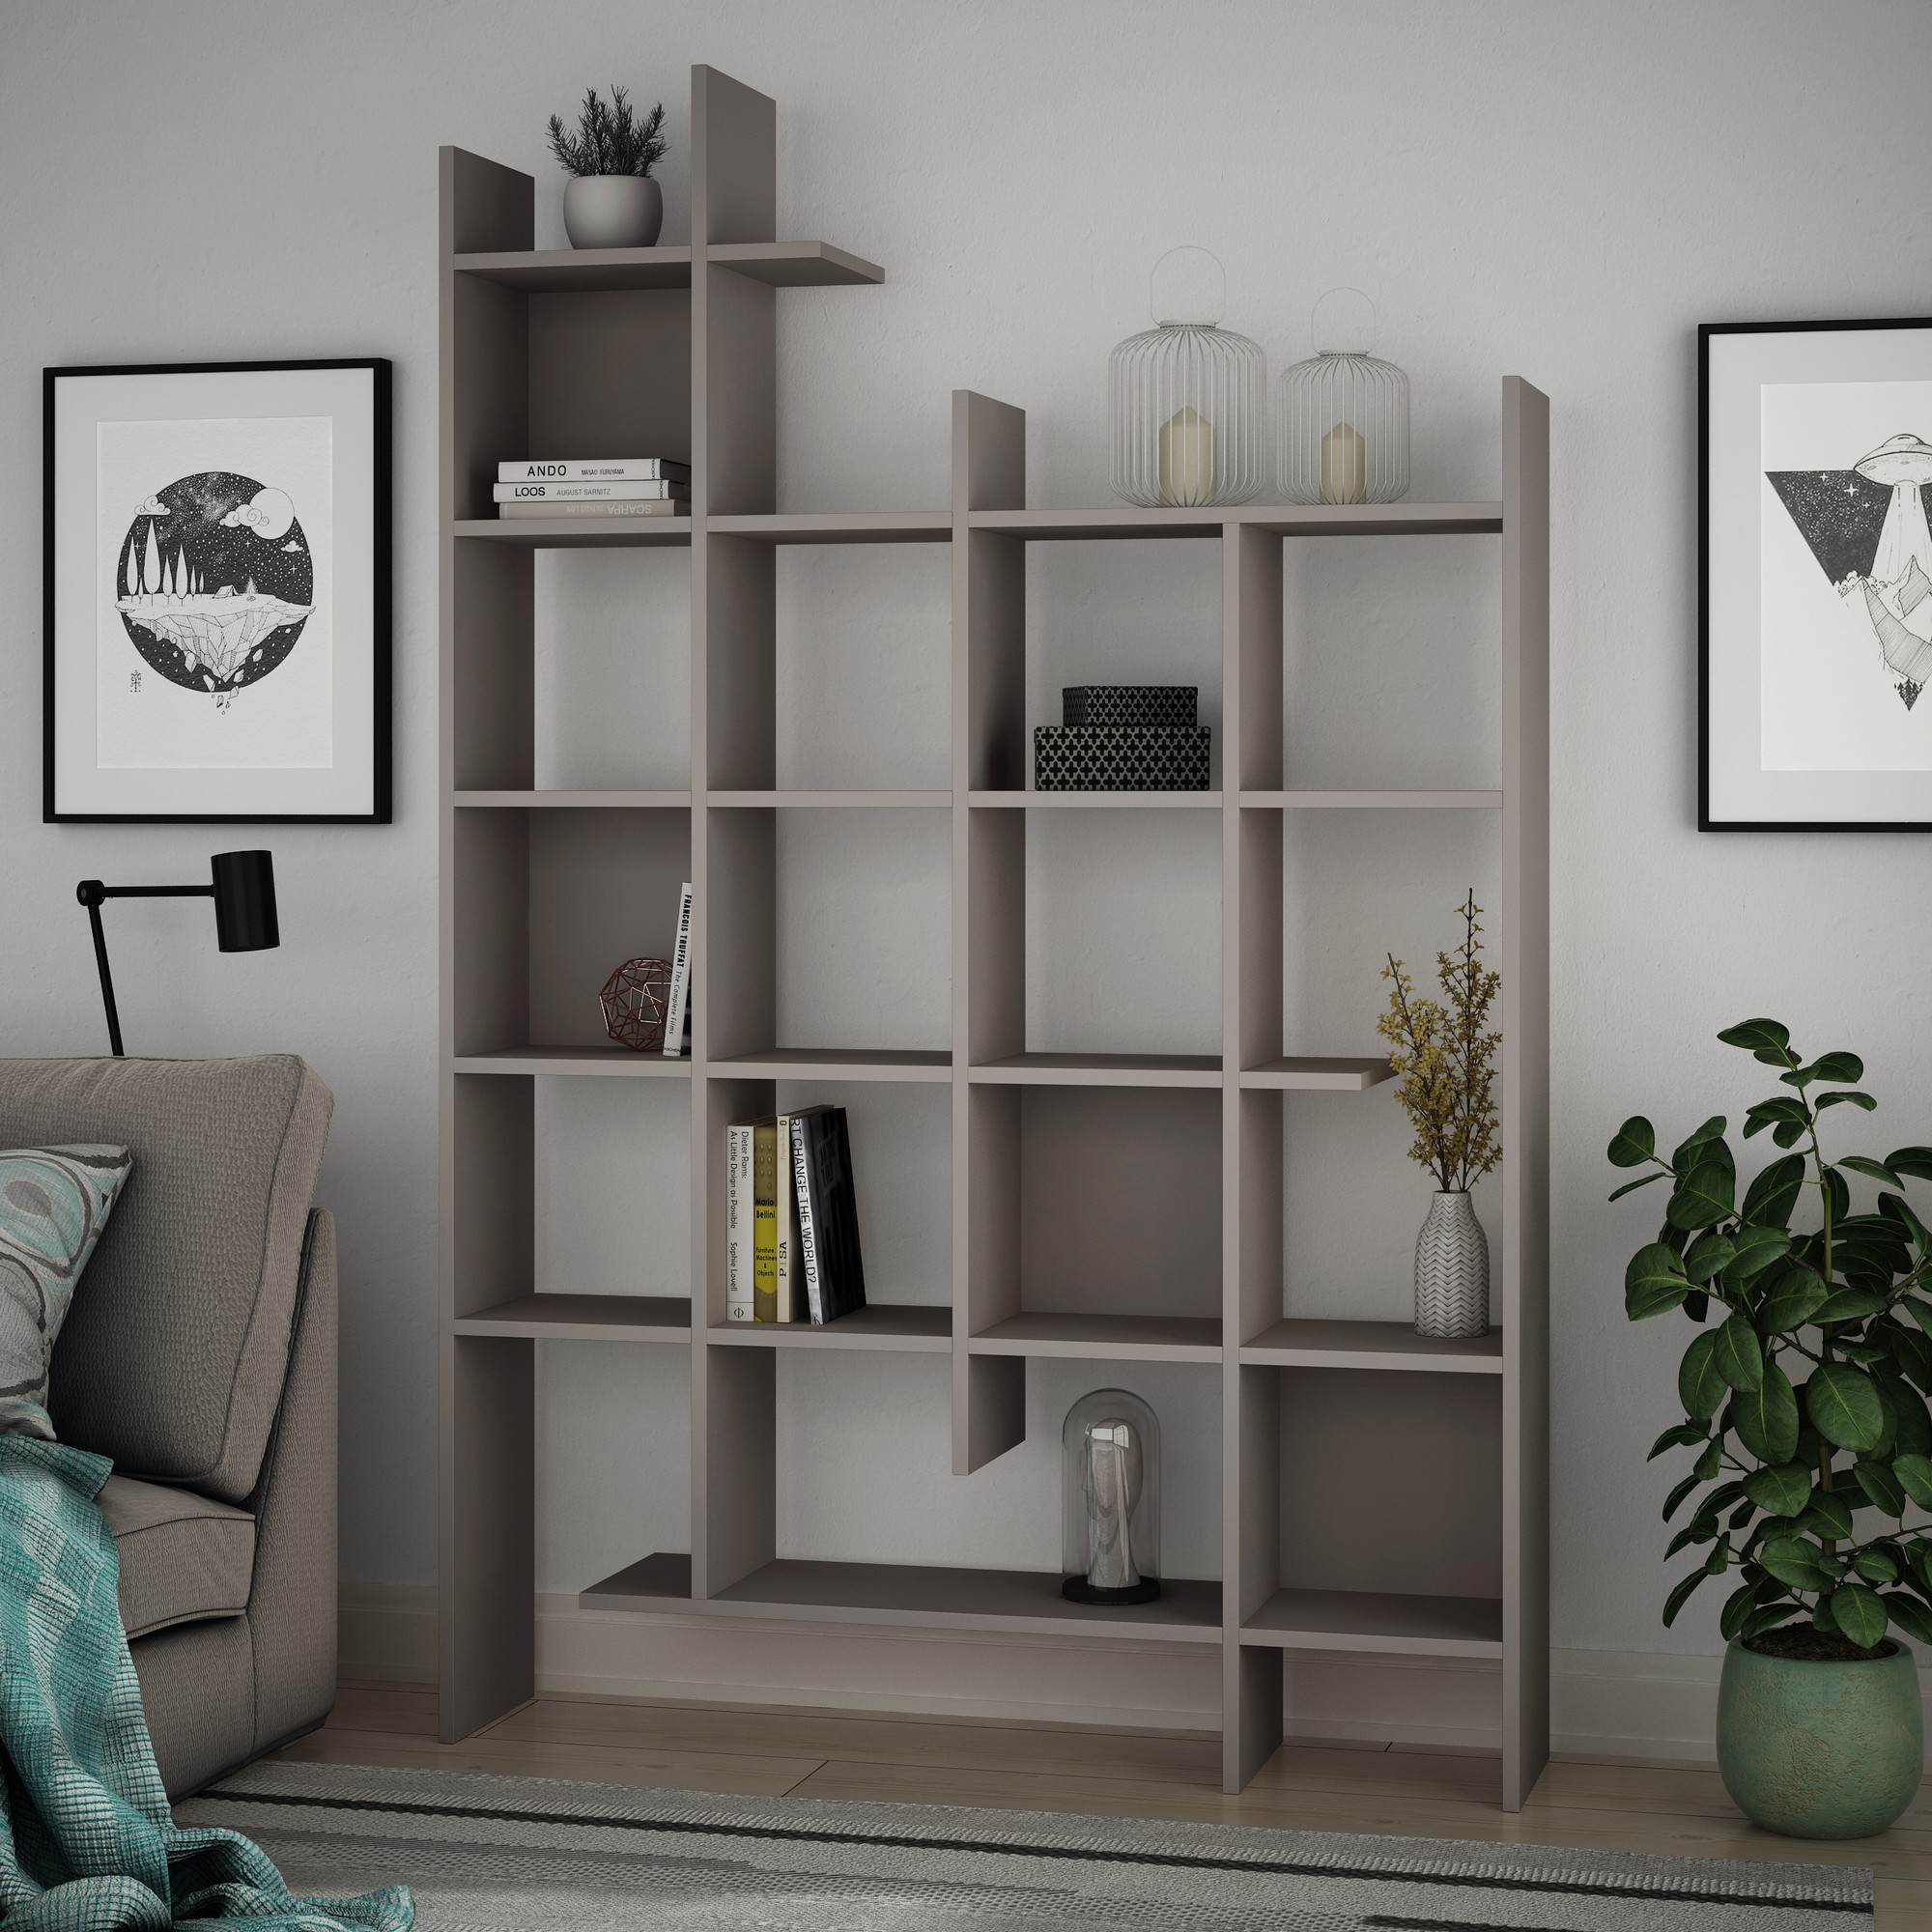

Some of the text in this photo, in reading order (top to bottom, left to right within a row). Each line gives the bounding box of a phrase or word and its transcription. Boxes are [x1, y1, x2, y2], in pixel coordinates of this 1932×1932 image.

[527, 465, 567, 477] ANDO
[515, 486, 546, 497] LOOS
[607, 504, 652, 515] SCARPA
[681, 895, 693, 932] FRANCOIS
[676, 935, 688, 968] TRUFFAT
[670, 984, 680, 1015] Complete
[668, 1016, 677, 1035] Films
[729, 1131, 737, 1141] As
[729, 1189, 736, 1198] as
[790, 1119, 817, 1283] RT CHANGE THE WORLD?
[756, 1197, 774, 1207] Mario
[779, 1241, 787, 1277] PISA
